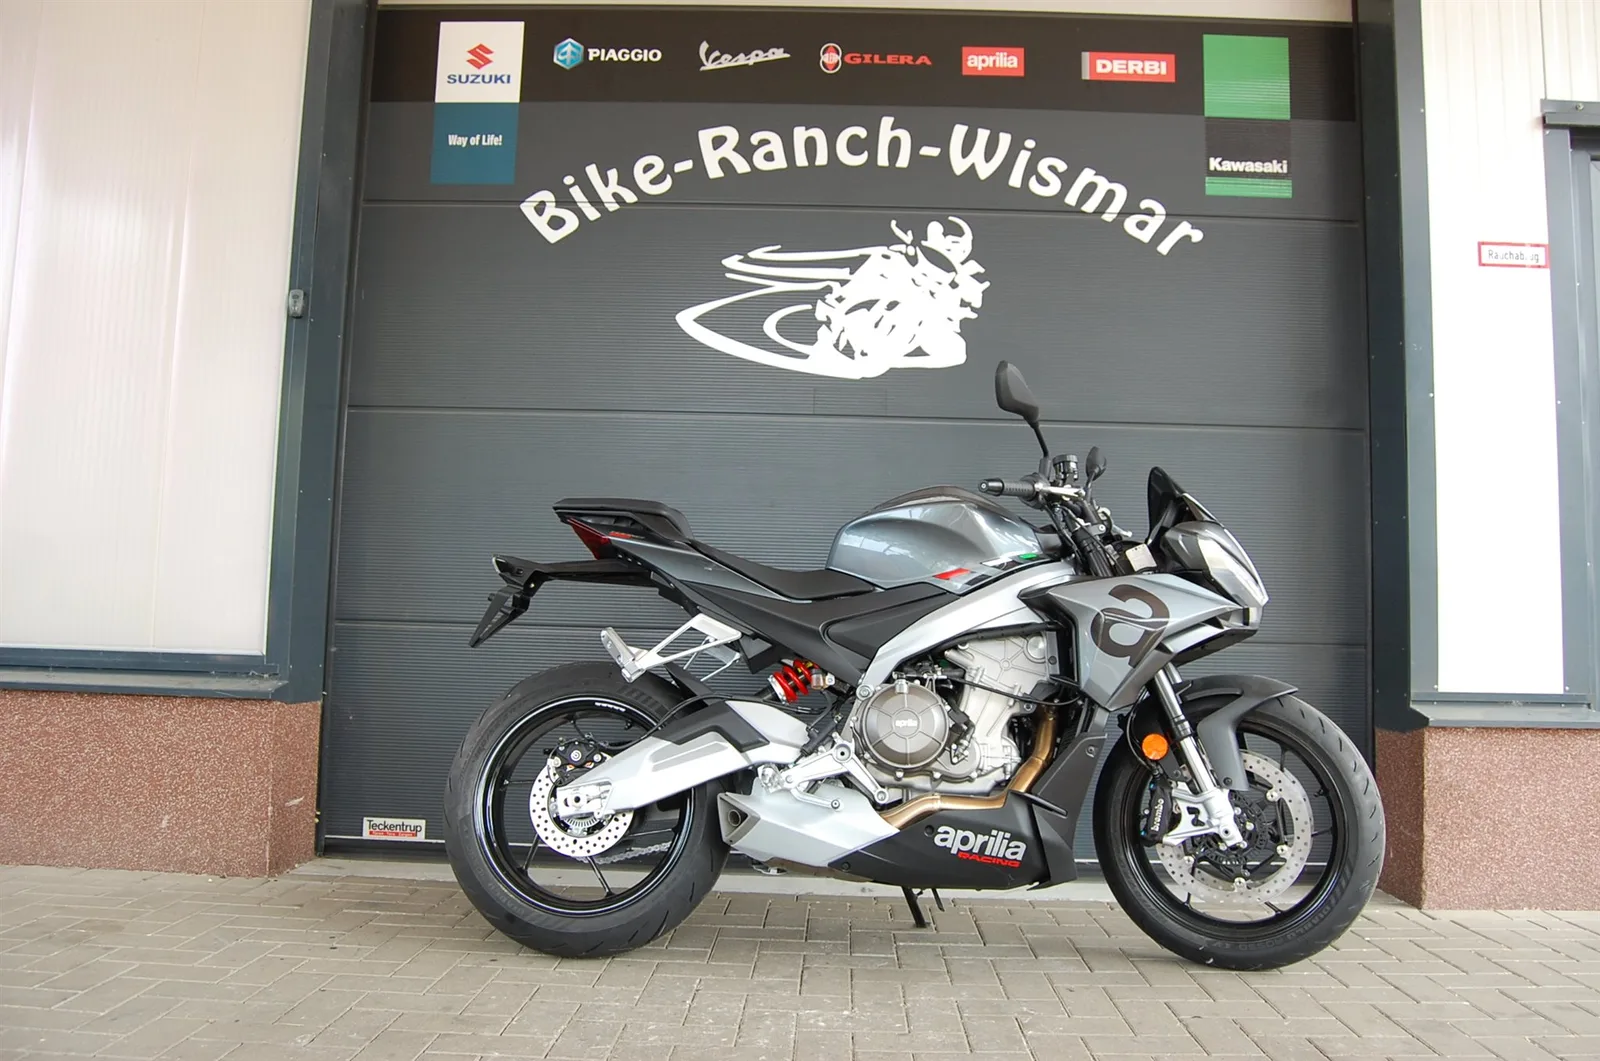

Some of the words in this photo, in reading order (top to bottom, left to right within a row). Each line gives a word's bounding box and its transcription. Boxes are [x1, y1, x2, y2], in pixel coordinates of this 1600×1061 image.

[587, 48, 662, 63] PIAGGIO
[699, 40, 790, 71] Vespa
[843, 53, 933, 66] GILERA
[966, 52, 1019, 70] aprilia
[1095, 58, 1168, 76] DERBI
[446, 73, 512, 85] SUZUKI
[448, 134, 469, 148] Way
[469, 134, 481, 146] of
[481, 134, 503, 146] Life!
[1209, 156, 1289, 175] Kawasaki
[1150, 798, 1165, 832] brembo
[366, 819, 423, 837] Teckentrup
[933, 825, 1027, 861] aprilia
[957, 851, 1021, 868] RACING
